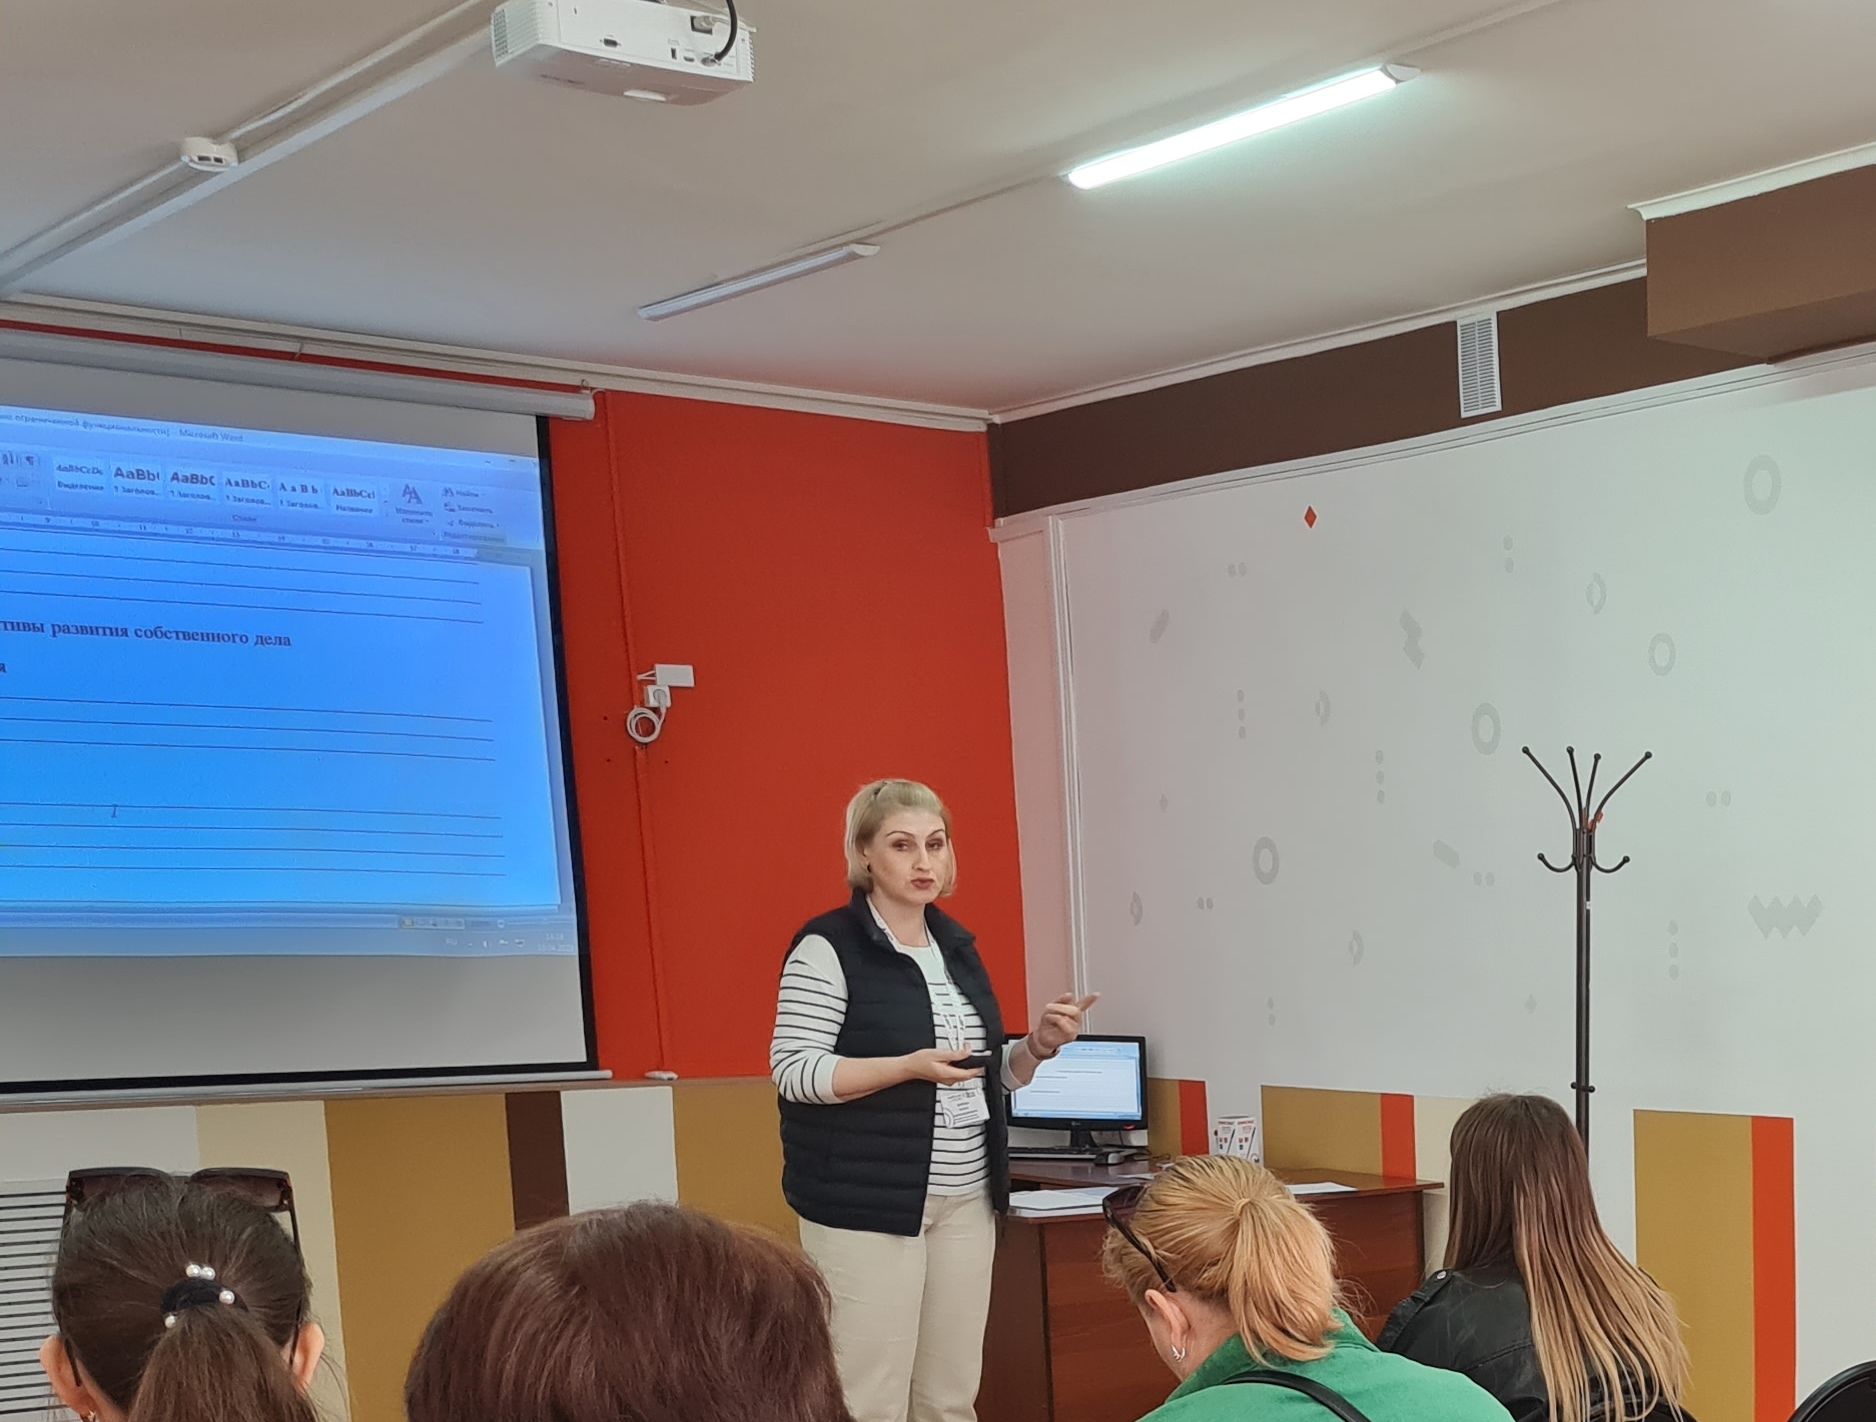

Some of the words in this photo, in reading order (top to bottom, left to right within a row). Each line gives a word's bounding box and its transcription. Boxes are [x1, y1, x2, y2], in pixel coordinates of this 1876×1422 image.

[51, 623, 130, 639] развития
[134, 626, 250, 645] собственного
[254, 634, 292, 647] дела
